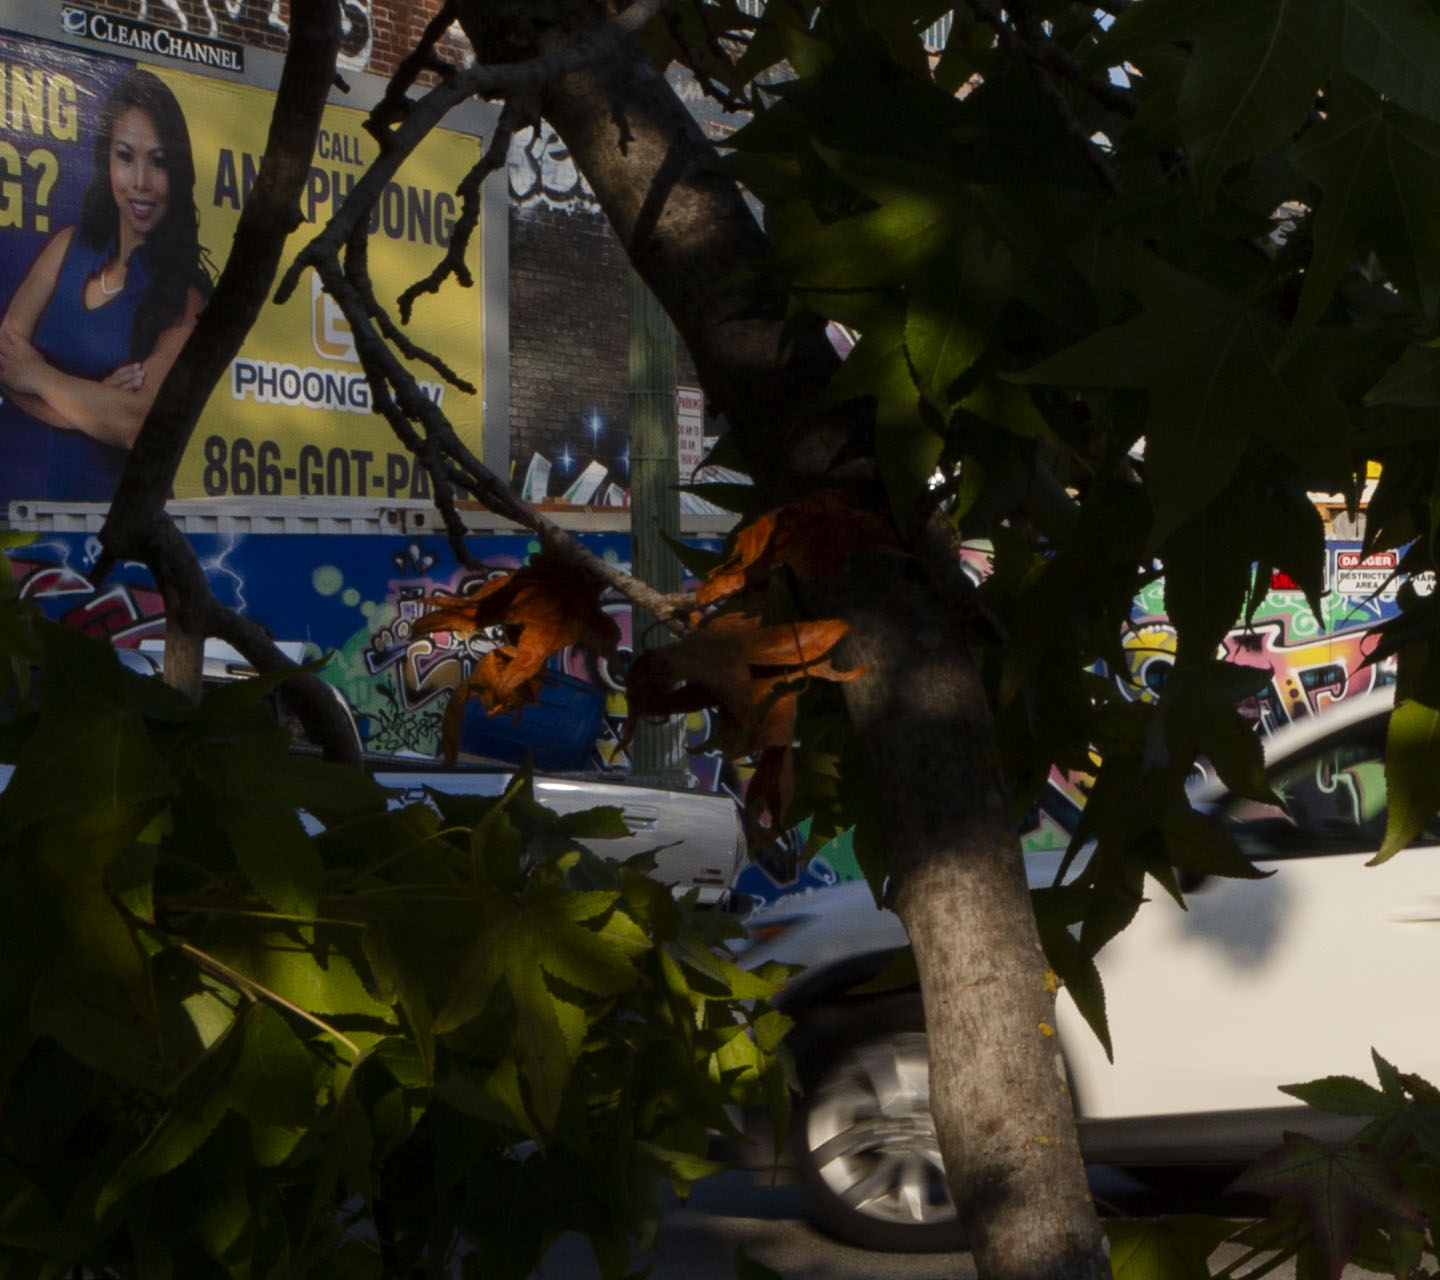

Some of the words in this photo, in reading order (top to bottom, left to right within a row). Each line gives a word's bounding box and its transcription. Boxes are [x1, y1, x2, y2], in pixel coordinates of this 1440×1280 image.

[318, 129, 363, 166] CALL
[234, 361, 370, 409] PHOONG
[1342, 556, 1391, 566] DAGER
